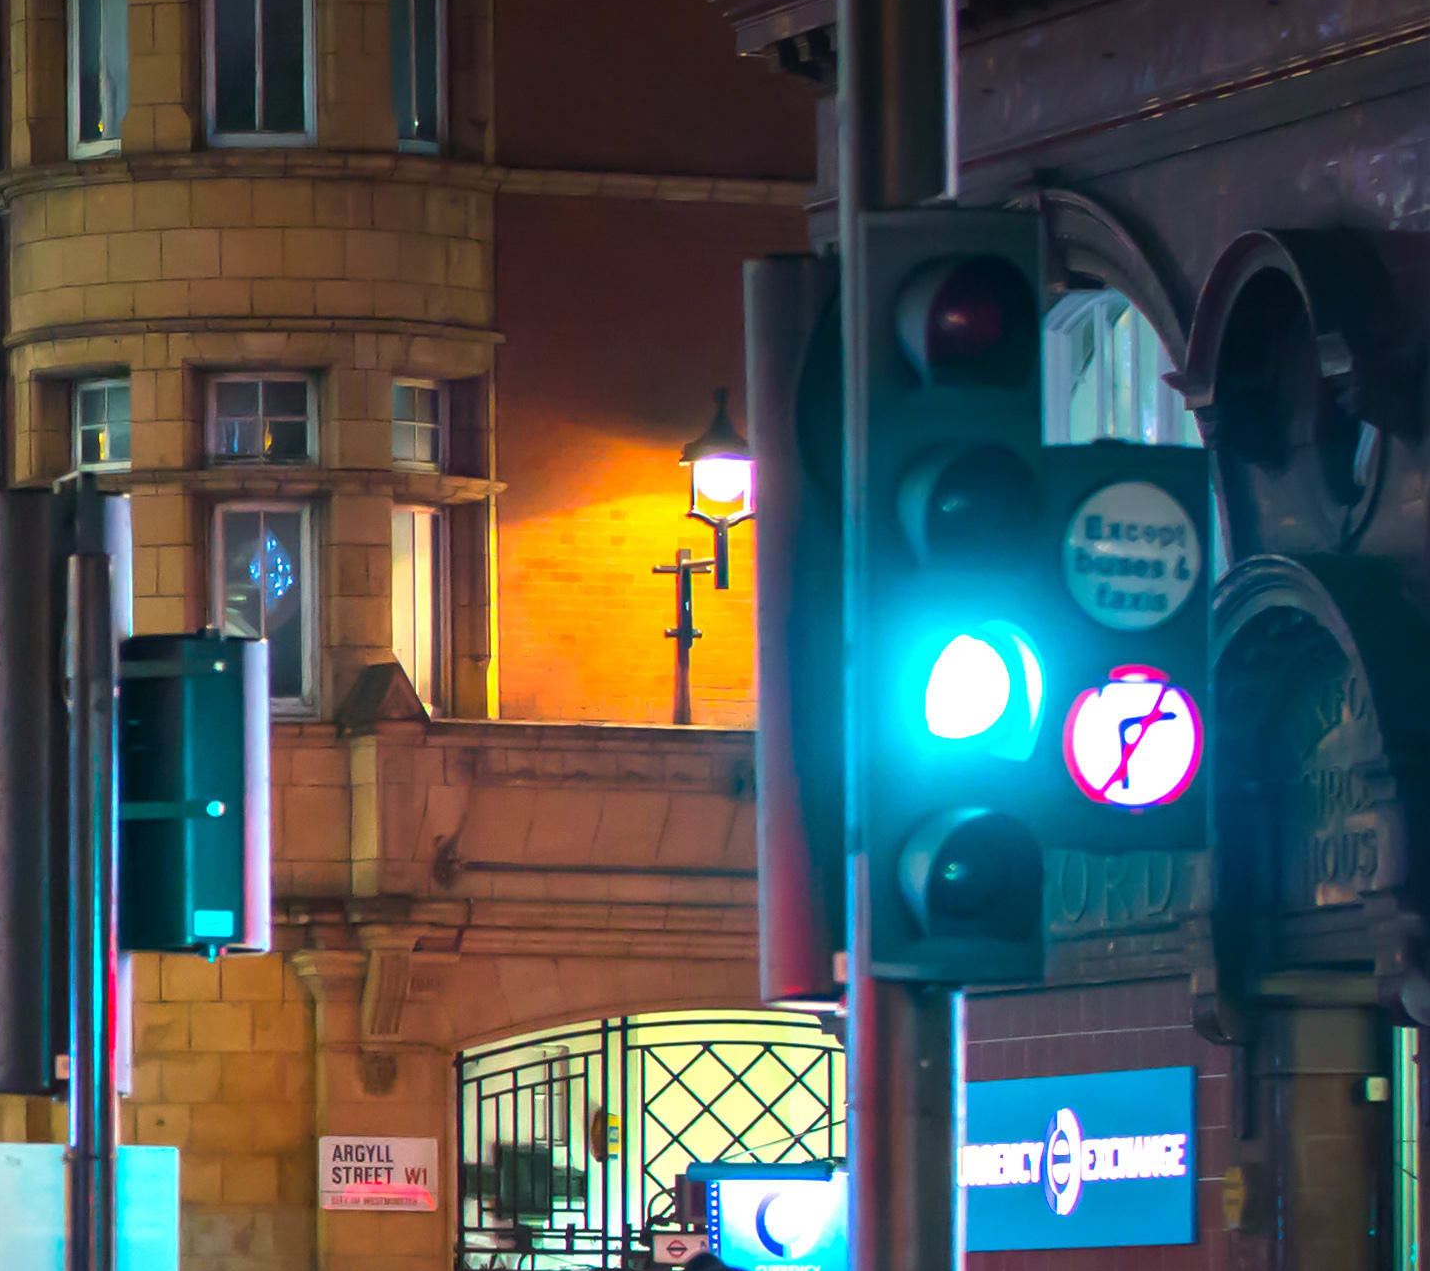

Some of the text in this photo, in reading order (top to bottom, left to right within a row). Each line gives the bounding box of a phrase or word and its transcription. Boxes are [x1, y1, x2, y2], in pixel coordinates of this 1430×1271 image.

[332, 1145, 394, 1162] ARGYLL
[332, 1167, 427, 1185] STREET W1
